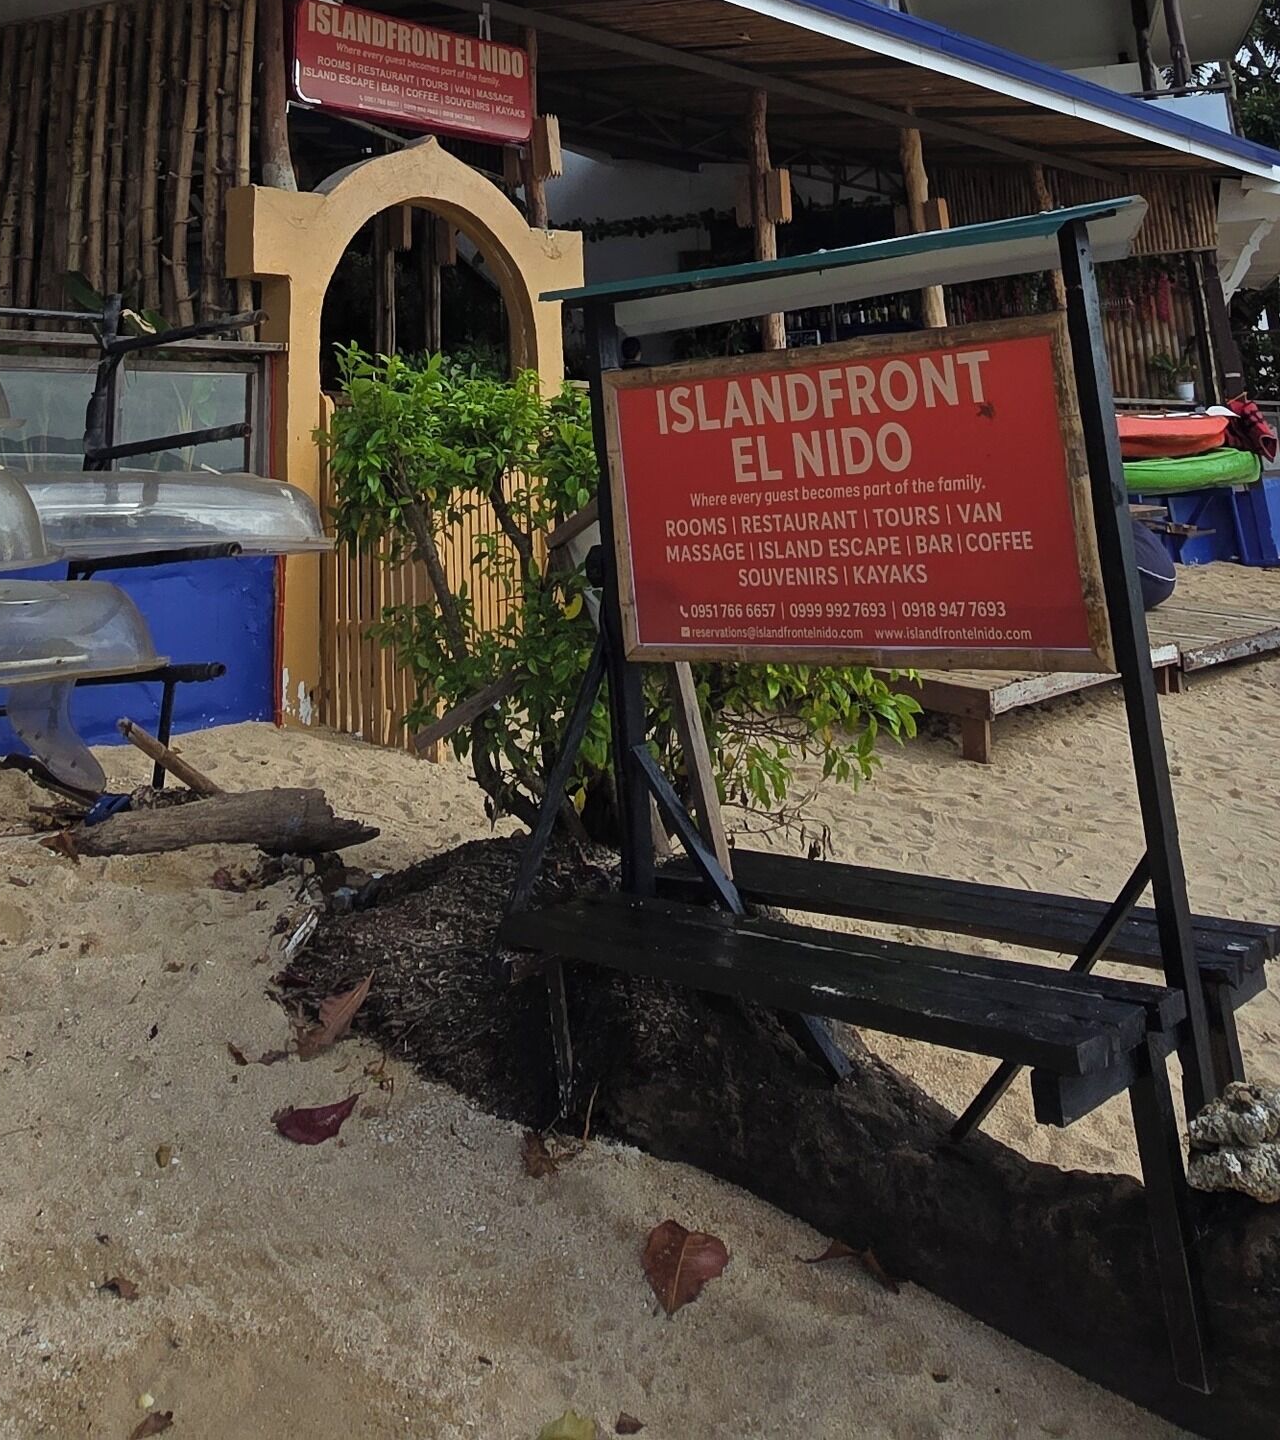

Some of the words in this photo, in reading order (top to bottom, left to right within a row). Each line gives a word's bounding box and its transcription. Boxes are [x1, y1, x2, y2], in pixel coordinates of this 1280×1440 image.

[308, 2, 450, 62] ISLANDFRONT
[455, 38, 475, 68] EL
[479, 43, 524, 78] NIDO
[317, 55, 351, 70] ROOMS
[357, 63, 414, 83] RESTAURANT
[420, 77, 449, 91] TOURS
[454, 84, 470, 96] VAN
[476, 89, 514, 104] MASSAGE
[336, 42, 361, 57] Where
[362, 50, 384, 63] every
[384, 55, 406, 66] guest
[407, 58, 439, 73] becomes
[441, 68, 456, 78] part
[466, 71, 478, 81] the
[303, 67, 337, 81] ISLAND
[339, 74, 375, 89] ESCAPE
[381, 82, 400, 94] BAR
[406, 87, 439, 102] COFFEE
[444, 95, 490, 112] SOUVENIRS
[495, 105, 526, 119] KAYAKS
[656, 350, 990, 435] ISLANDFRONT
[731, 435, 783, 483] EL
[792, 422, 912, 479] NIDO
[690, 493, 727, 507] Where
[730, 492, 762, 507] every
[764, 487, 799, 506] guest
[802, 486, 860, 500] becomes
[863, 480, 891, 500] part
[895, 479, 909, 494] of
[912, 478, 935, 493] the
[937, 474, 986, 494] family.
[665, 517, 727, 538] ROOMS
[741, 510, 858, 534] RESTAURANT
[873, 505, 940, 528] TOURS
[957, 502, 1002, 524] VAN
[666, 542, 745, 563] MASSAGE
[758, 539, 823, 560] ISLAND
[829, 536, 901, 557] ESCAPE
[915, 534, 954, 555] BAR
[965, 531, 1034, 553] COFFEE
[738, 566, 839, 587] SOUVENIRS
[852, 563, 928, 585] KAYAKS
[690, 604, 718, 618] 0951
[720, 603, 743, 618] 766
[745, 603, 776, 618] 6657
[789, 602, 823, 618] 0999
[825, 602, 851, 618] 992
[852, 602, 887, 617] 7693
[901, 601, 936, 617] 0918
[938, 601, 965, 617] 947
[969, 601, 1007, 617] 7693
[692, 626, 864, 639] reservations@islandfrontelnido.com
[875, 626, 1032, 640] www.islandfrontelnido.com
